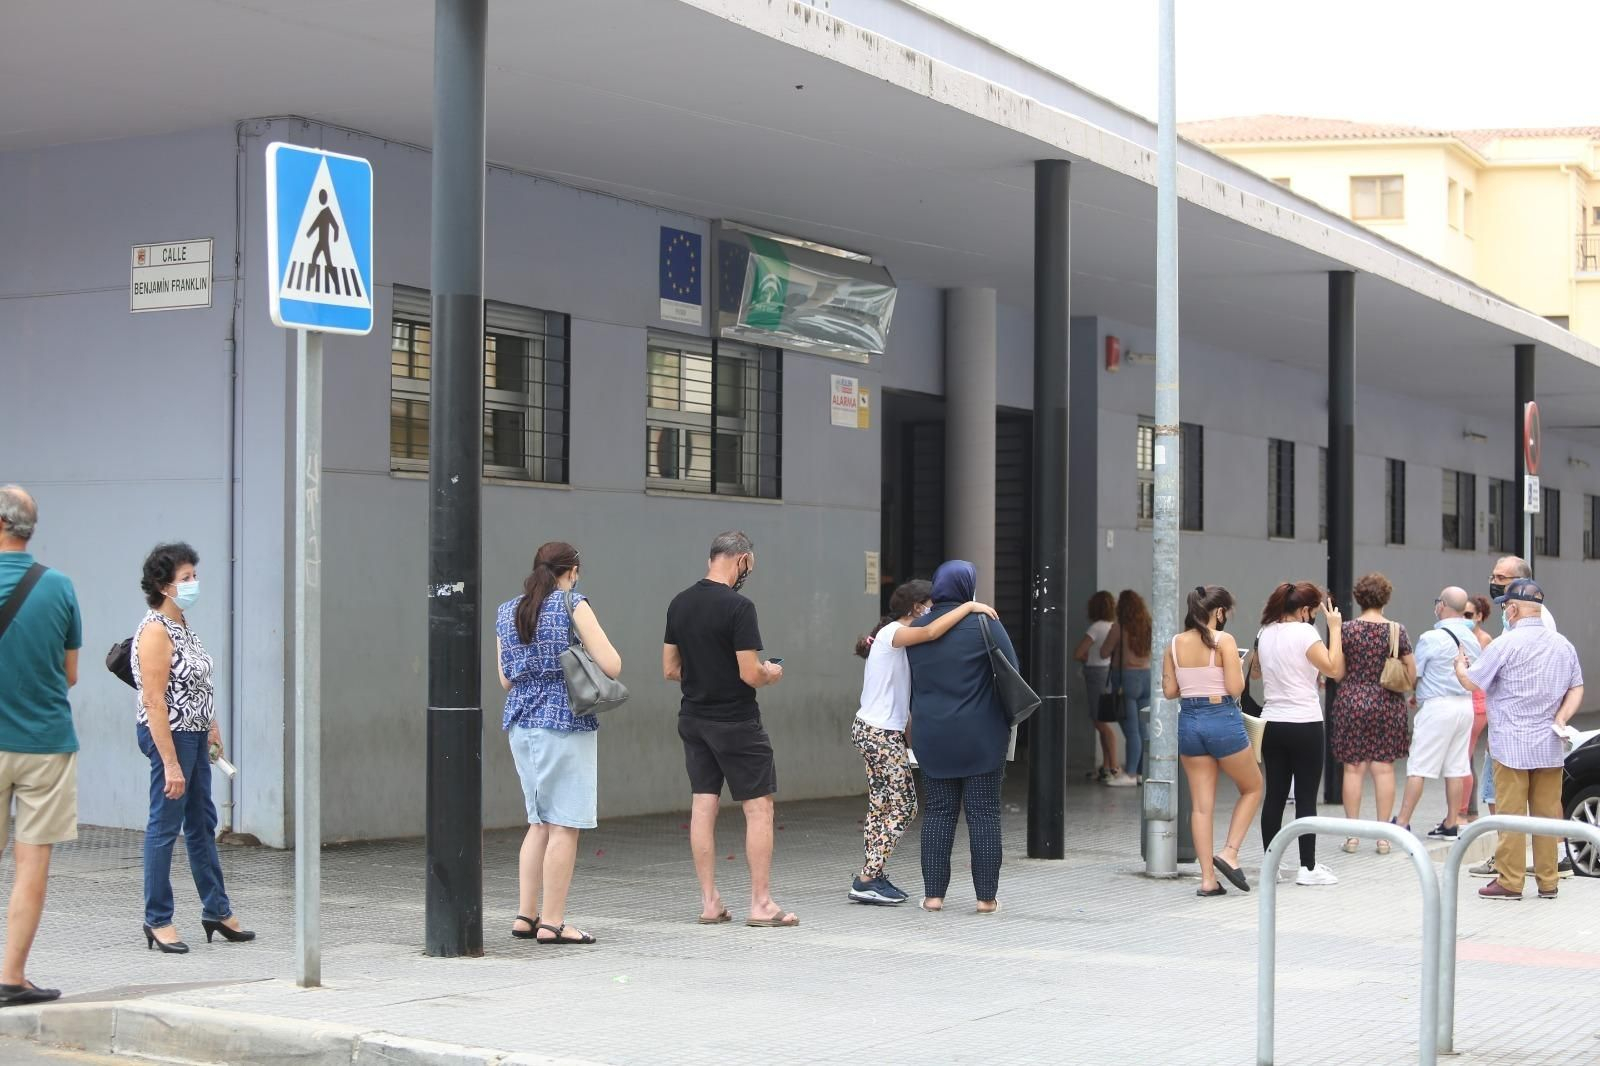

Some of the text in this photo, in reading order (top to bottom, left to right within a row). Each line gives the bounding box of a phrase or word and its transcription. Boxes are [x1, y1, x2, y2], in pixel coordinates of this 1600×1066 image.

[162, 247, 187, 262] CALLE
[134, 277, 207, 295] BENJAMÍN FRANKLIN
[832, 394, 857, 409] ALARMA
